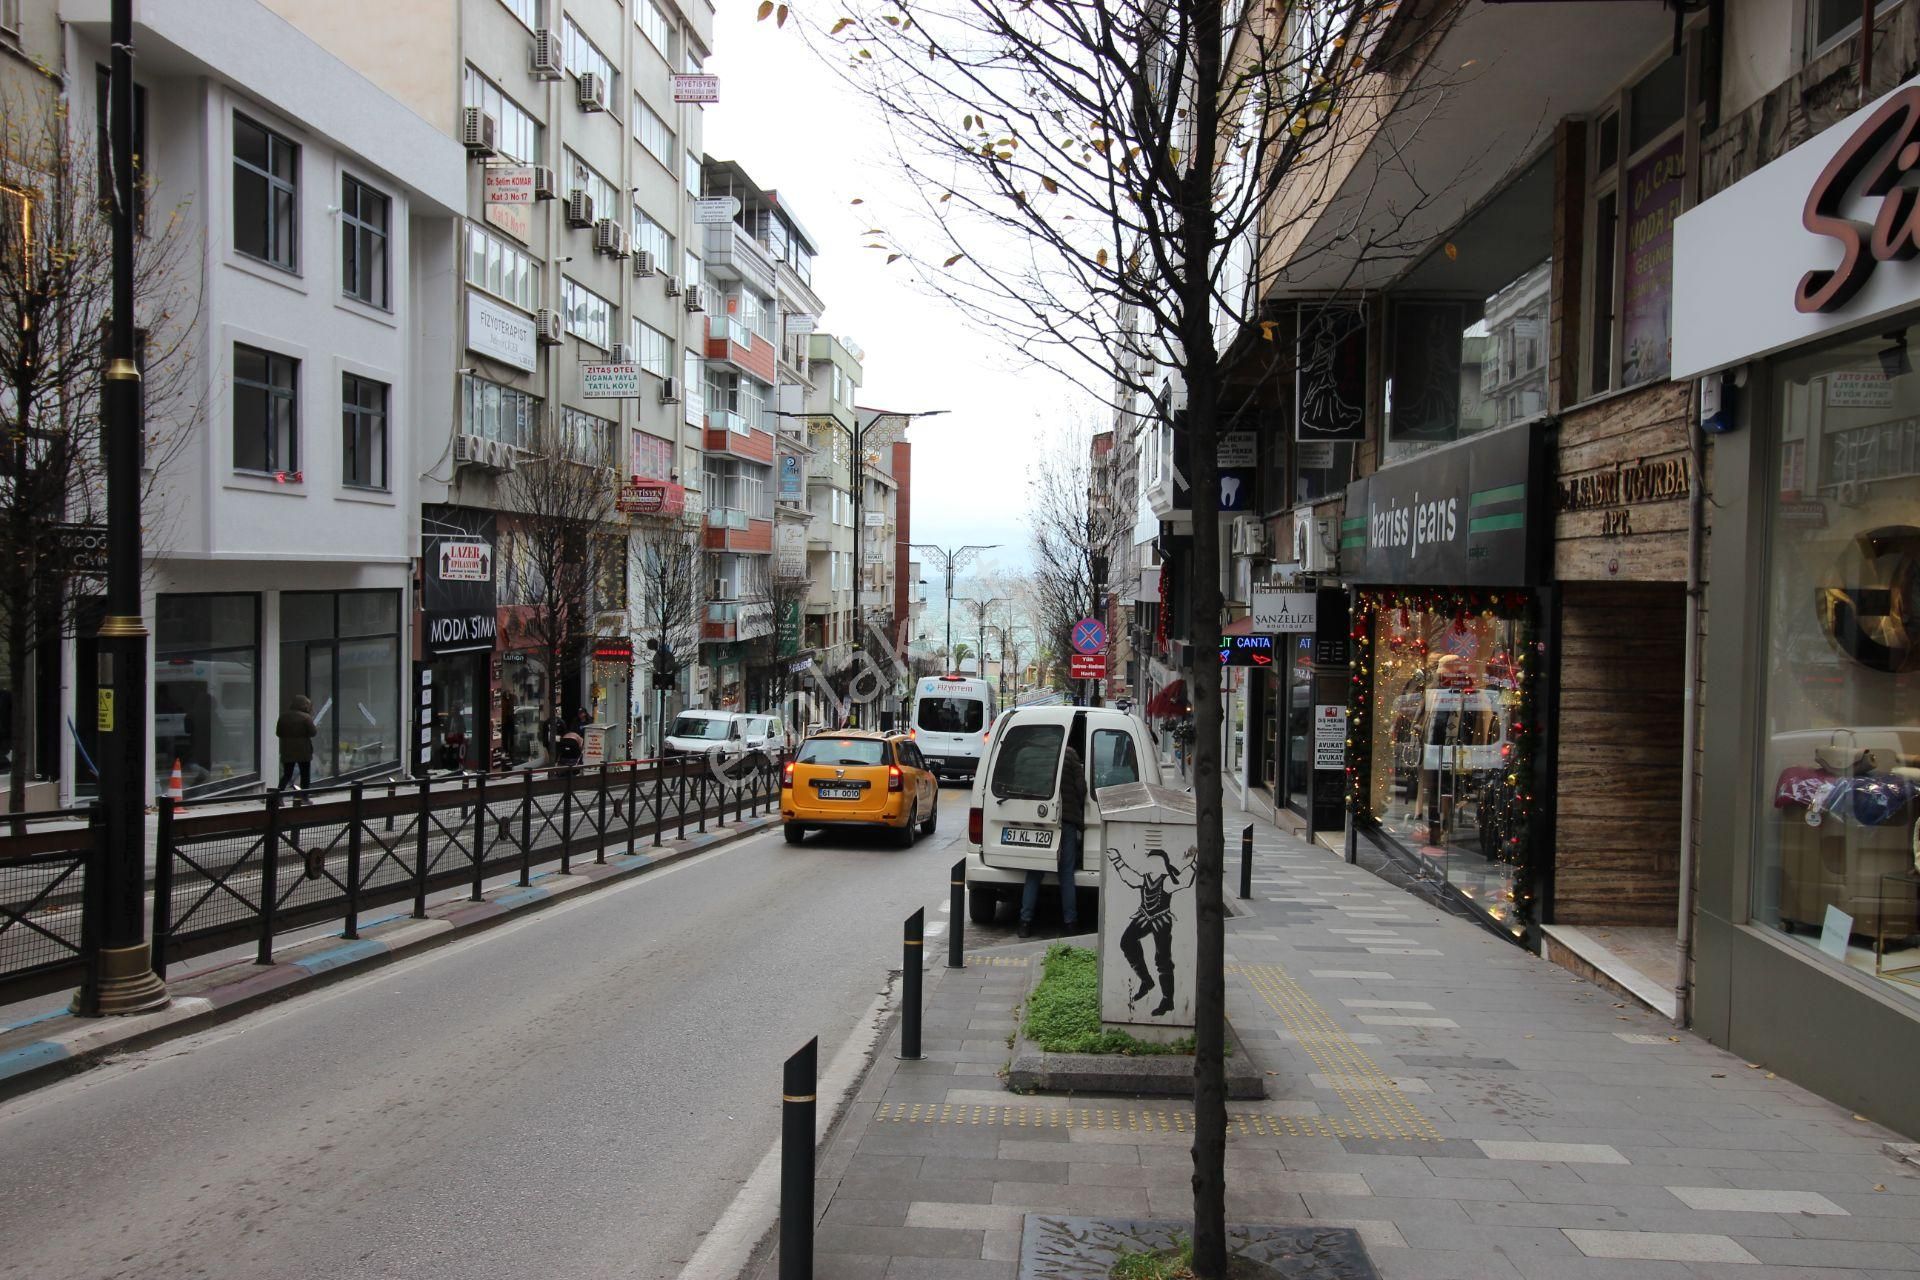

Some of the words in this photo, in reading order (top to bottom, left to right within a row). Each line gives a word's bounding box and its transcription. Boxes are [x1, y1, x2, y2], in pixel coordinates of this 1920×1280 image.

[1371, 498, 1409, 549] bariss
[1411, 492, 1457, 559] jeans
[450, 546, 480, 559] LAZER
[1255, 612, 1315, 625] ŞANZELİZE
[431, 618, 468, 643] MODA
[471, 615, 497, 640] SİMA
[822, 789, 830, 797] 61
[841, 790, 859, 798] 0010
[1019, 830, 1030, 842] KL
[1035, 831, 1051, 844] 120
